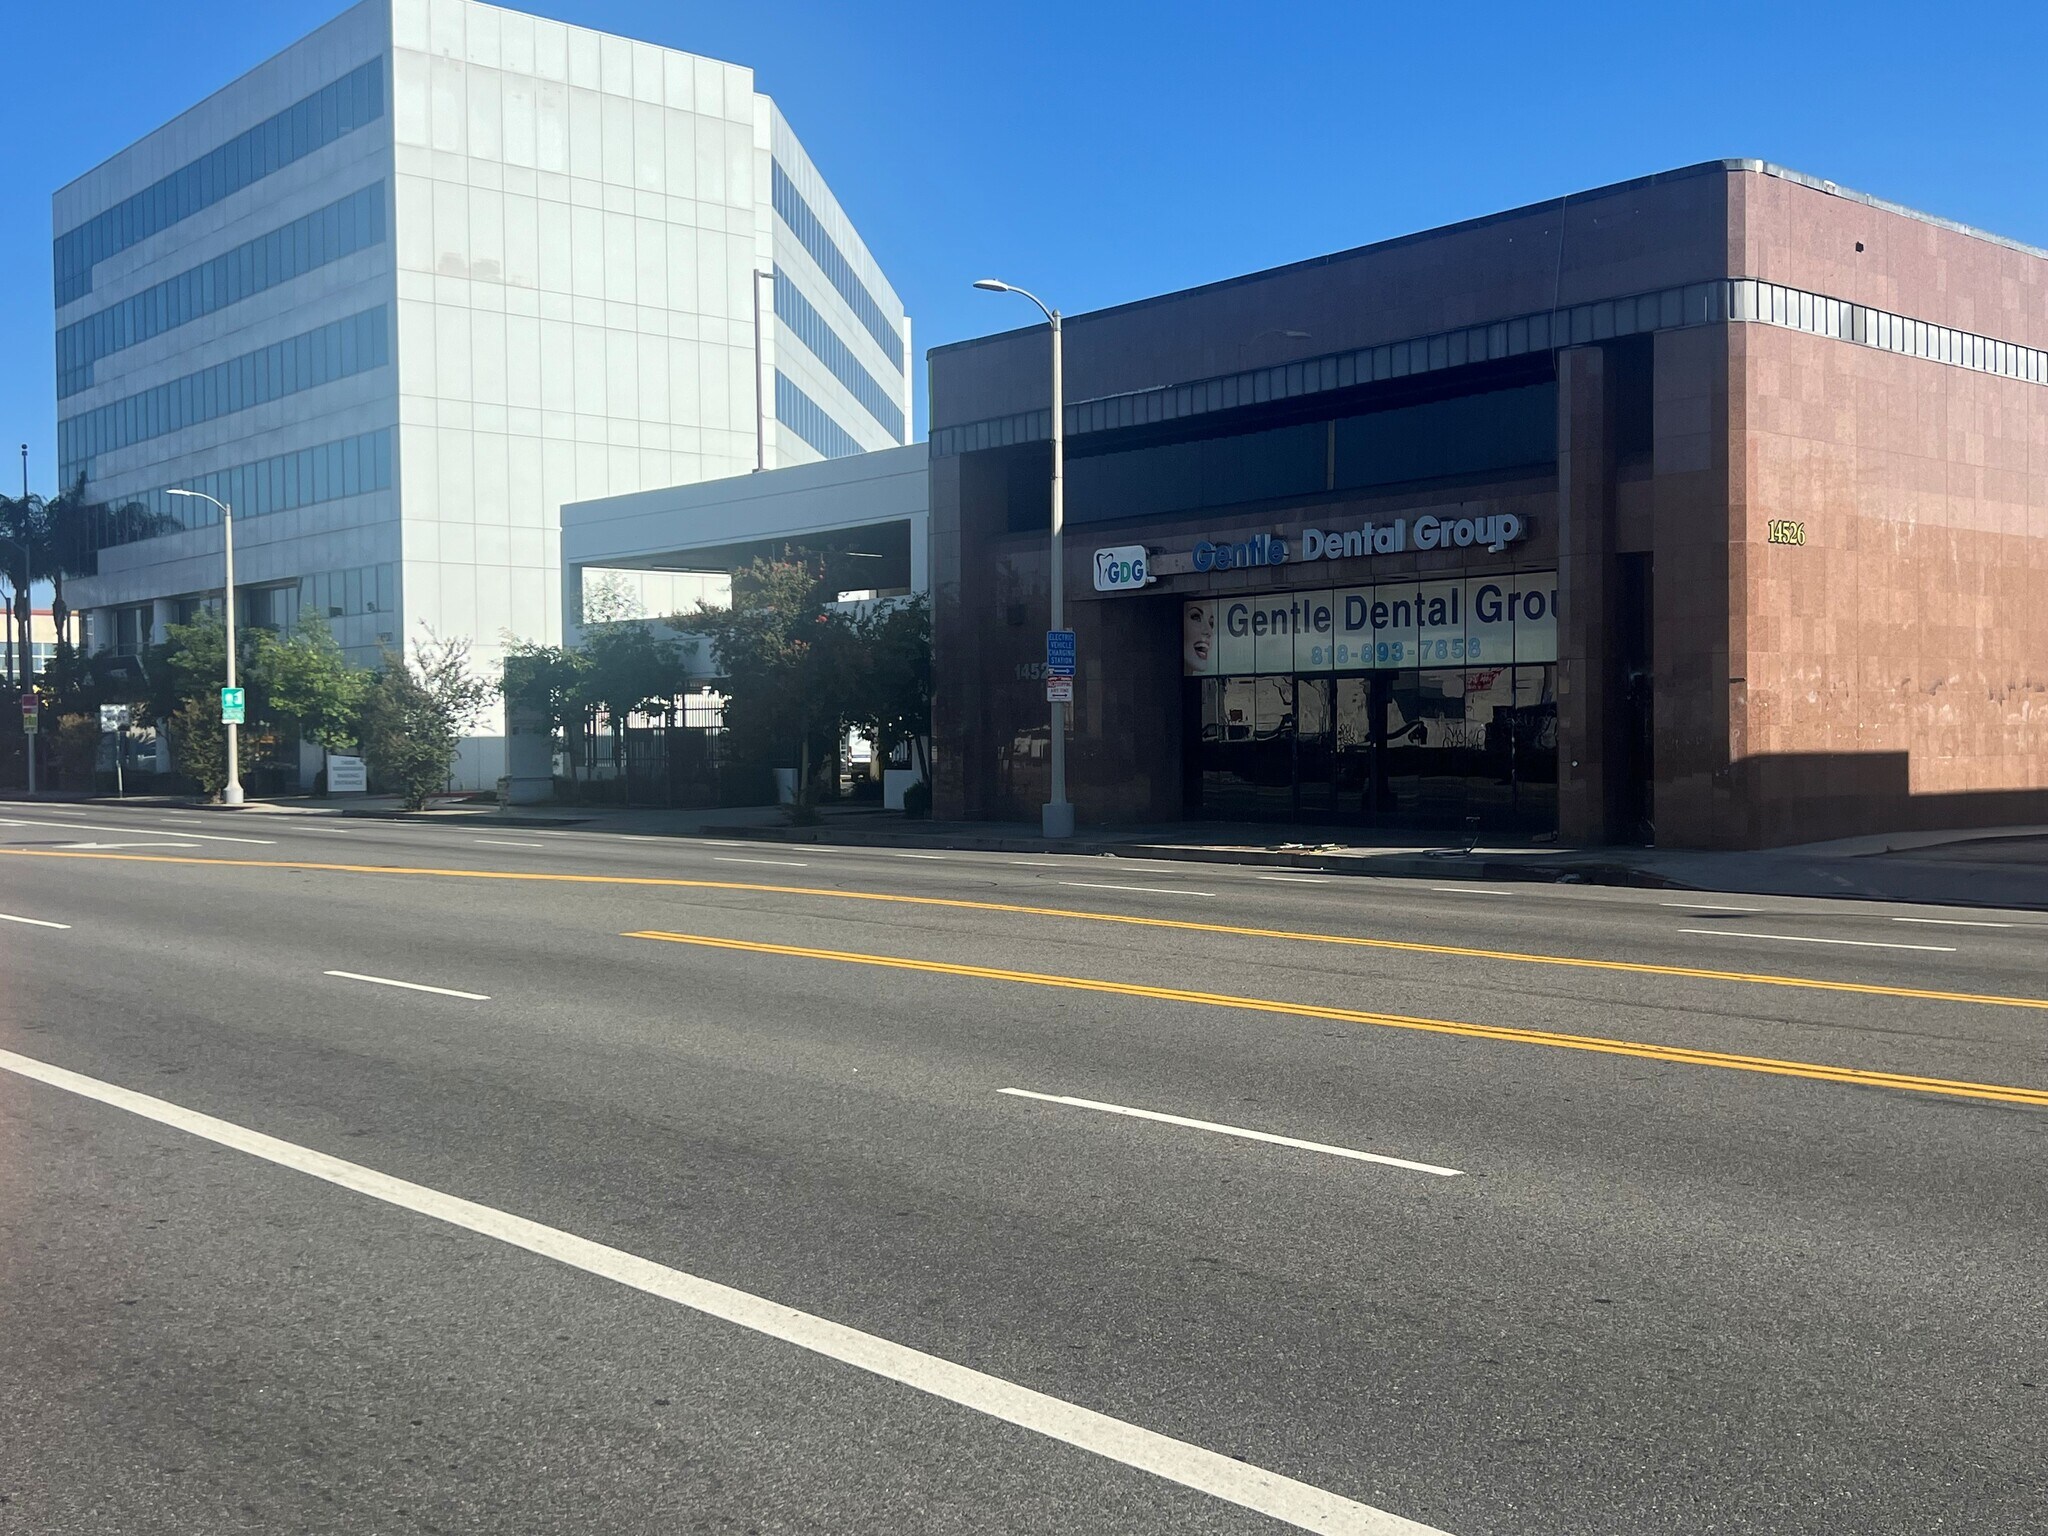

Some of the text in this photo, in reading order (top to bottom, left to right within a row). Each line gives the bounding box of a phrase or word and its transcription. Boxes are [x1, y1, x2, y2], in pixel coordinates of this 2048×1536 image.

[1192, 513, 1519, 573] Gentle Dental Group
[1767, 519, 1806, 546] 14526
[1107, 559, 1144, 584] GDG
[1227, 599, 1331, 638] Gentle
[1345, 587, 1459, 631] Dental
[1049, 633, 1074, 641] ELECTRIC
[1050, 641, 1073, 649] VEHICLE
[1049, 649, 1075, 657] CHARGING
[1311, 637, 1482, 665] 818-893-7858
